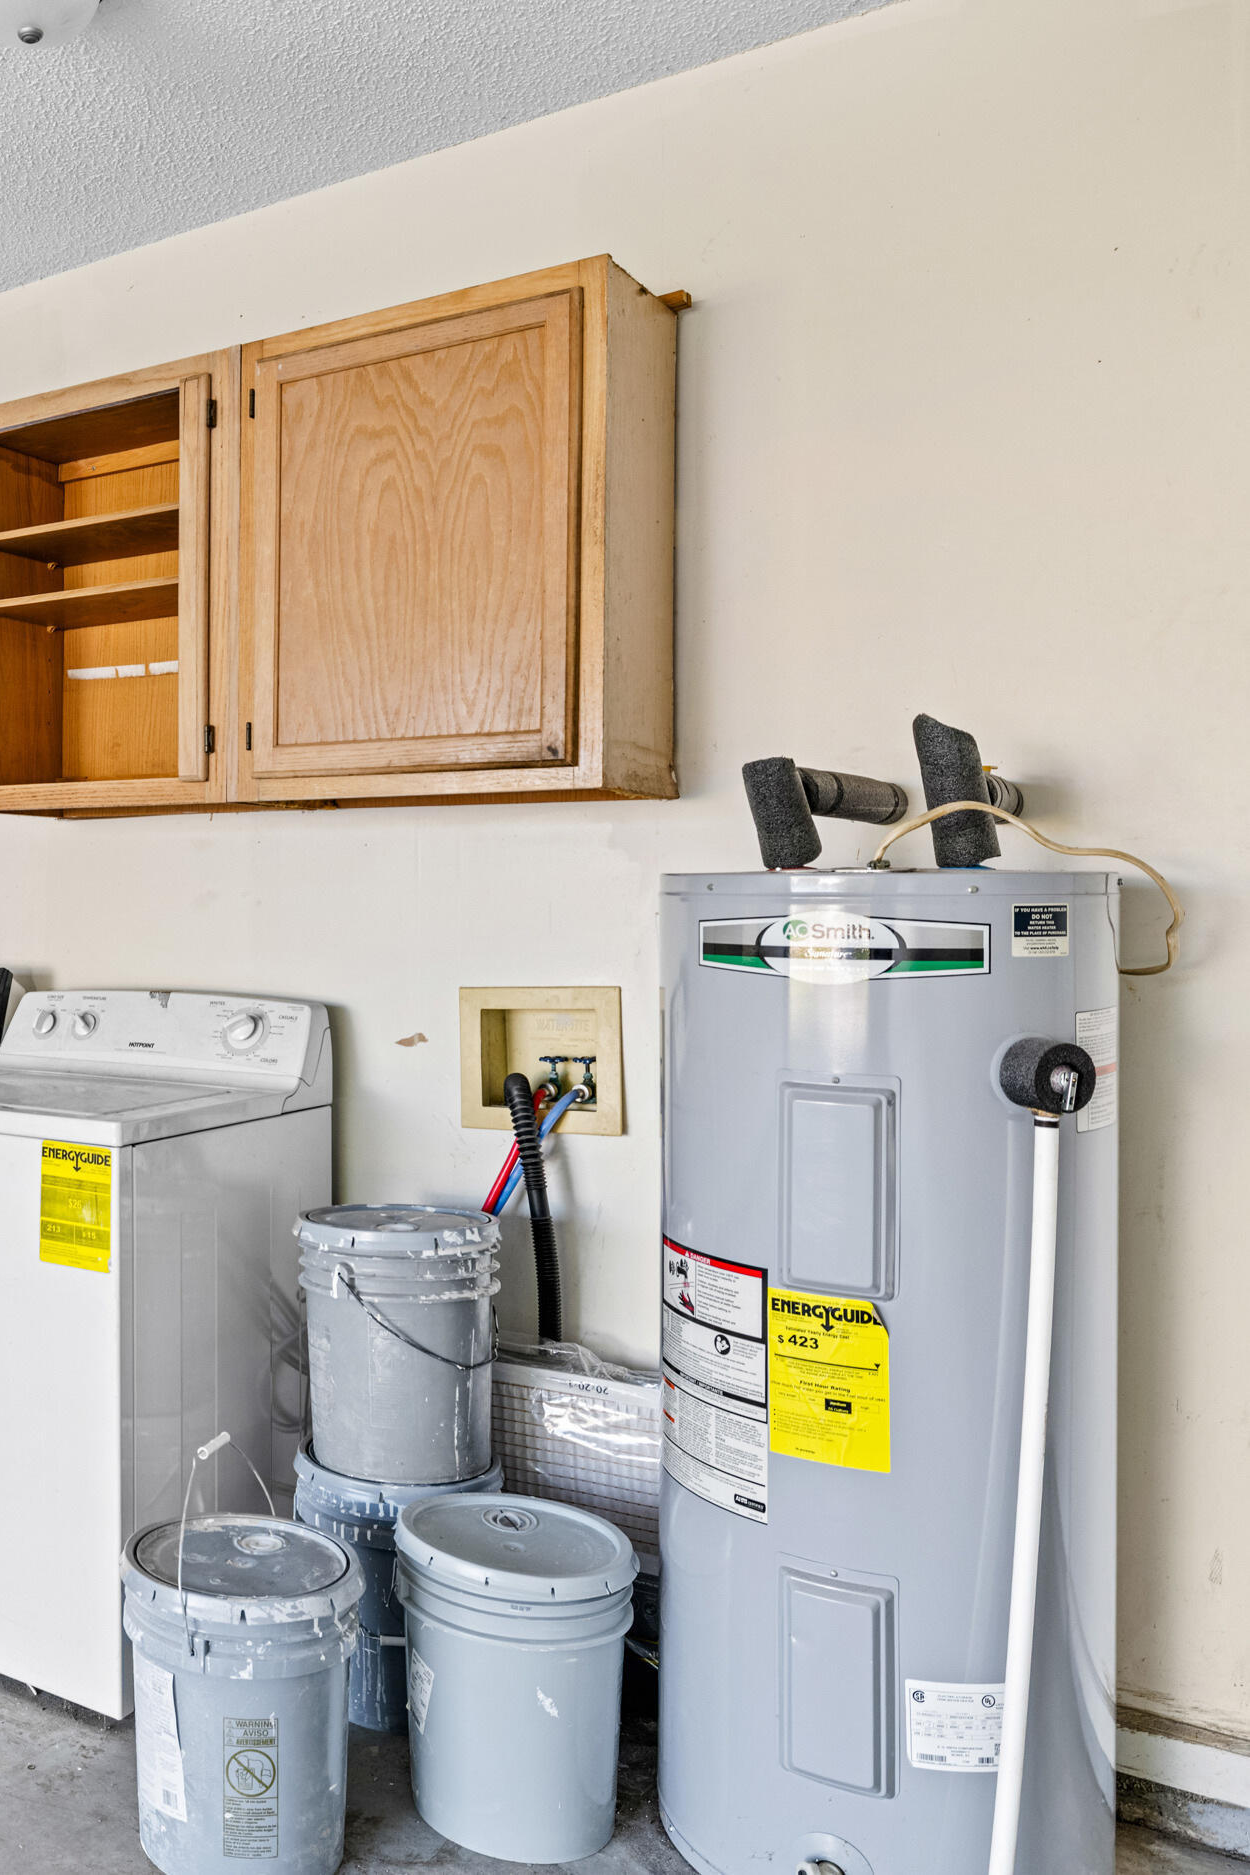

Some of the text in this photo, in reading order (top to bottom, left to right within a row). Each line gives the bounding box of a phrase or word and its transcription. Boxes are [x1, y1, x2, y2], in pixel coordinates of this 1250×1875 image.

[41, 1146, 111, 1168] ENERGYGUIDE
[690, 1251, 711, 1265] DANGER
[777, 1334, 819, 1350] $ 423
[243, 1729, 269, 1737] AVISO
